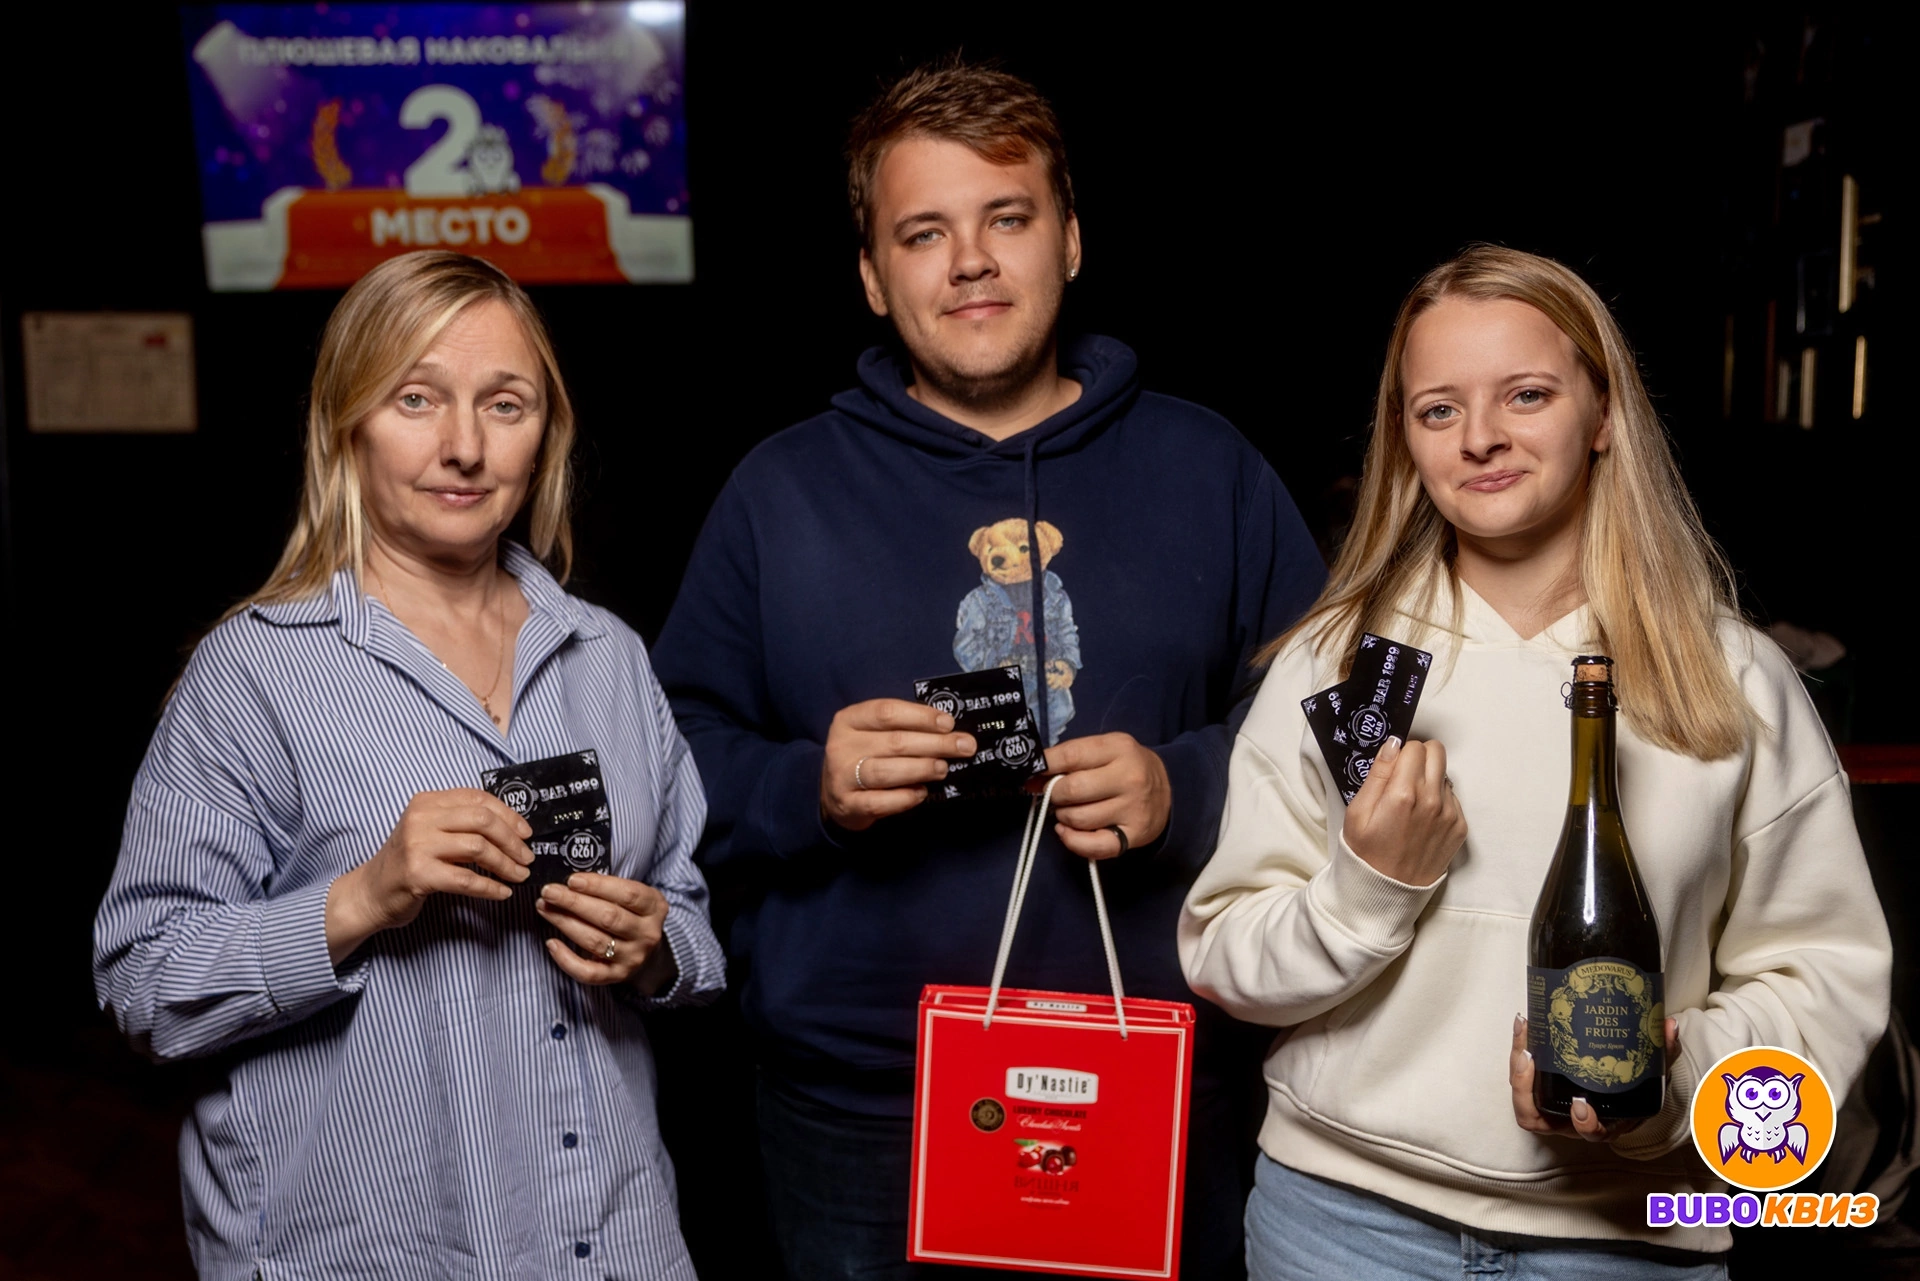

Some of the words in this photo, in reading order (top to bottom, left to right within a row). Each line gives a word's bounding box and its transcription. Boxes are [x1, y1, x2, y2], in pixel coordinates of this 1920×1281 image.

[398, 83, 484, 198] 2
[371, 207, 530, 246] МЕСТО
[1372, 678, 1392, 706] BAR
[965, 695, 992, 711] BAR
[1359, 713, 1376, 738] 1929
[1373, 720, 1384, 738] BAR
[1005, 741, 1027, 758] 1929
[504, 790, 527, 807] 1929
[539, 785, 568, 802] BAR
[571, 843, 595, 859] 1929
[1580, 963, 1634, 977] MEDOVARUS
[1602, 996, 1612, 1004] LE
[1584, 1004, 1629, 1016] JARDIN
[1595, 1016, 1619, 1027] DES
[1584, 1027, 1629, 1039] FRUITS
[1016, 1072, 1089, 1096] Dy'Nastie
